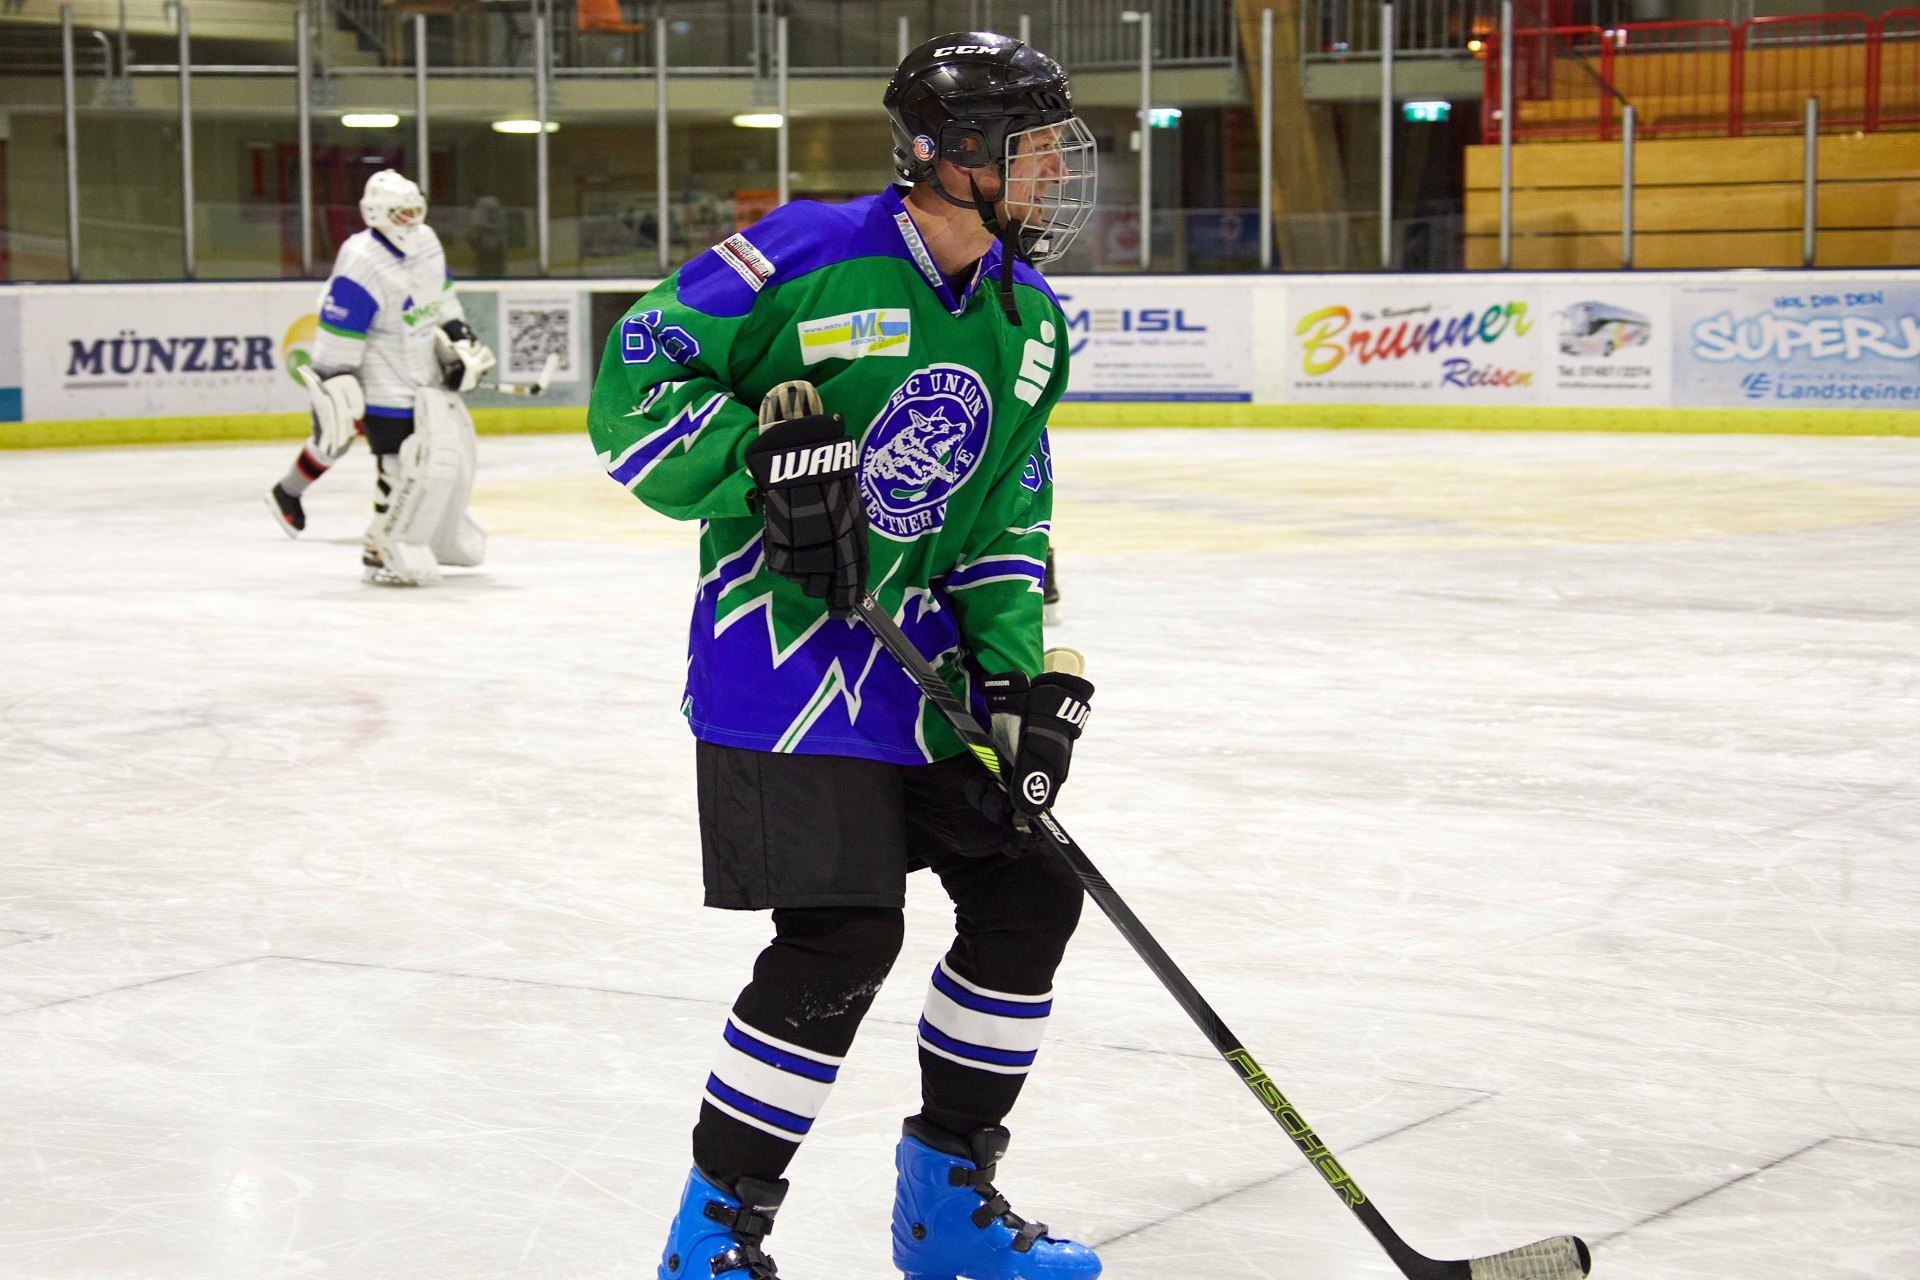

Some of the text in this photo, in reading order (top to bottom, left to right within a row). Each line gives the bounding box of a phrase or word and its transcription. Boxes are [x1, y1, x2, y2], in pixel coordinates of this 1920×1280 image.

[933, 45, 1000, 58] CCM
[66, 330, 276, 376] MÜNZER
[1295, 300, 1534, 376] Brunner
[891, 373, 984, 418] EC UNION
[1440, 358, 1533, 388] Reisen
[1225, 1047, 1366, 1209] FISCHER
